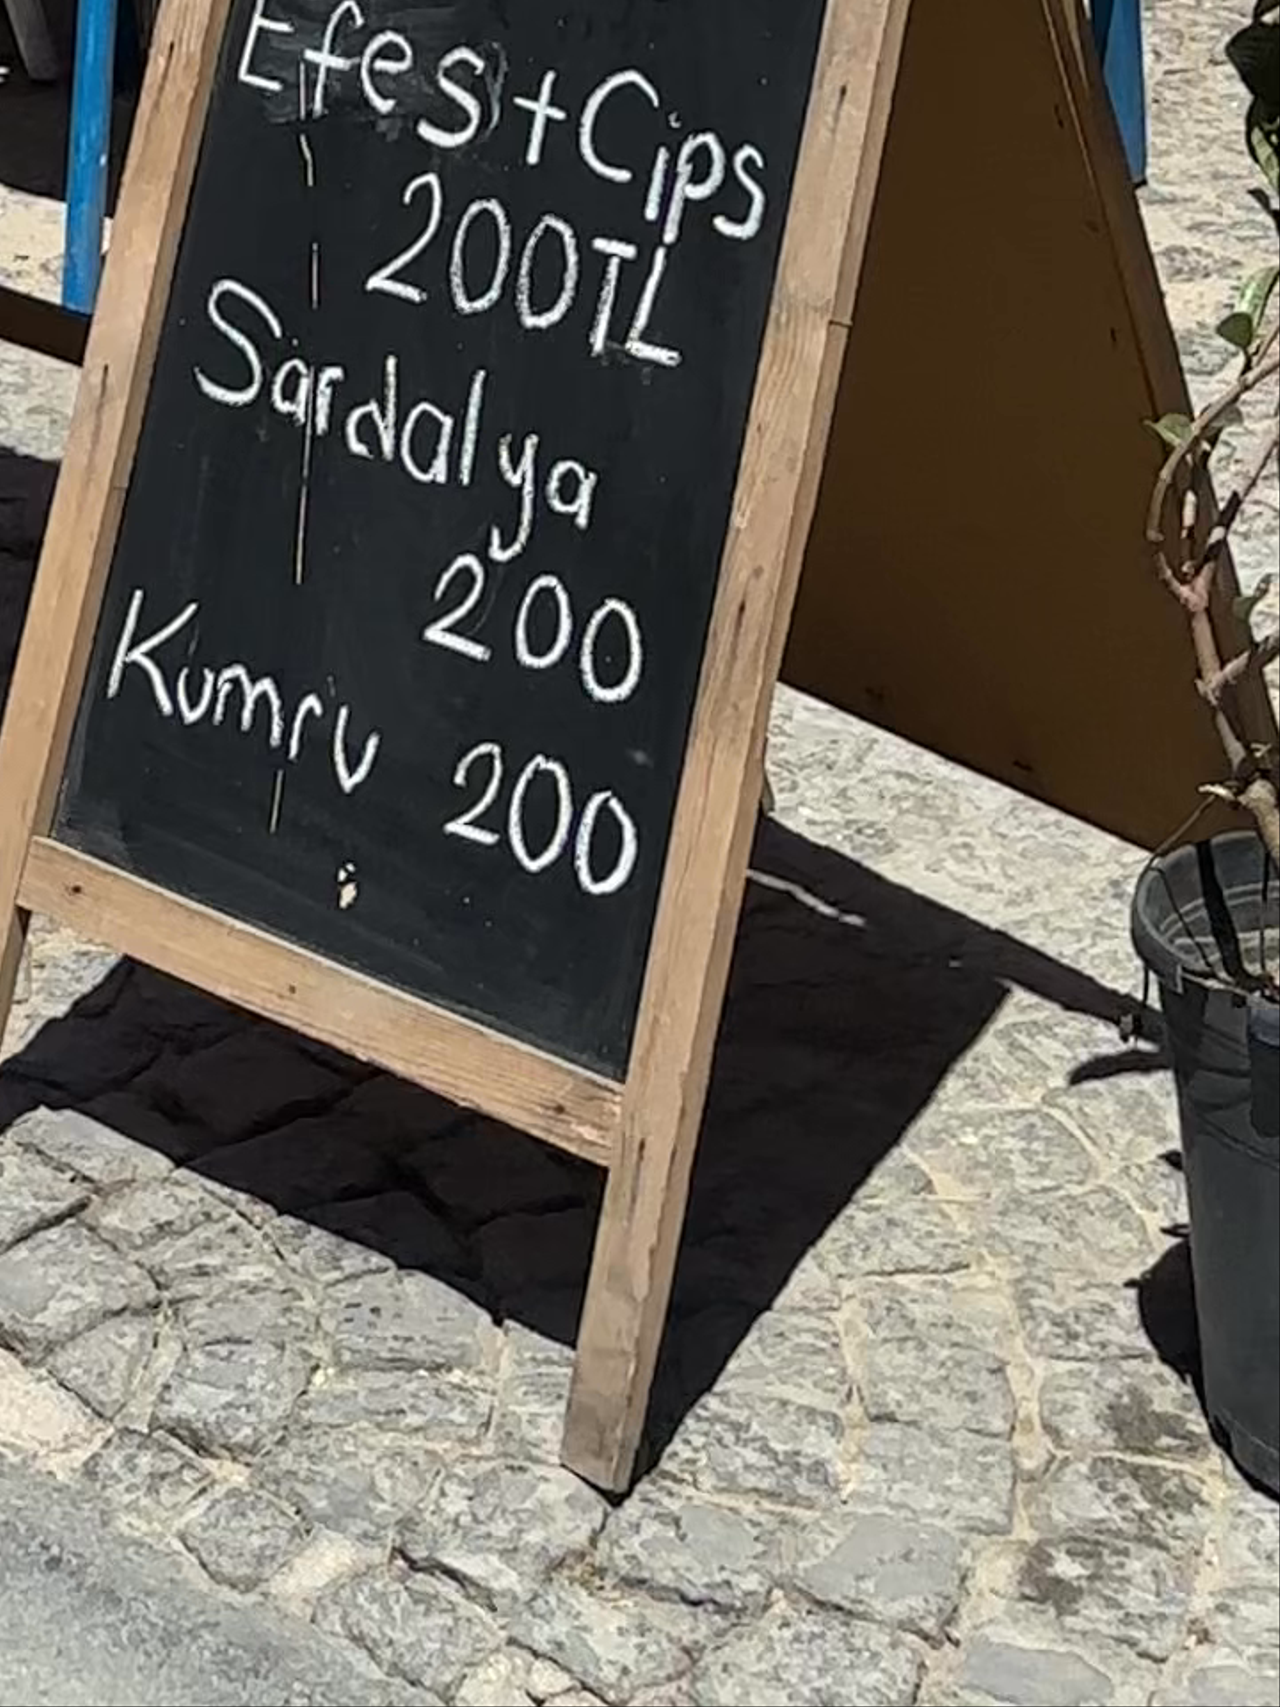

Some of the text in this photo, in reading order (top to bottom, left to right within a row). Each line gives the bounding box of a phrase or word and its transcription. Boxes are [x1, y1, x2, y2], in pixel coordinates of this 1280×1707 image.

[367, 168, 683, 366] 200TL
[423, 552, 642, 703] 200
[108, 587, 639, 897] Kumru 200
